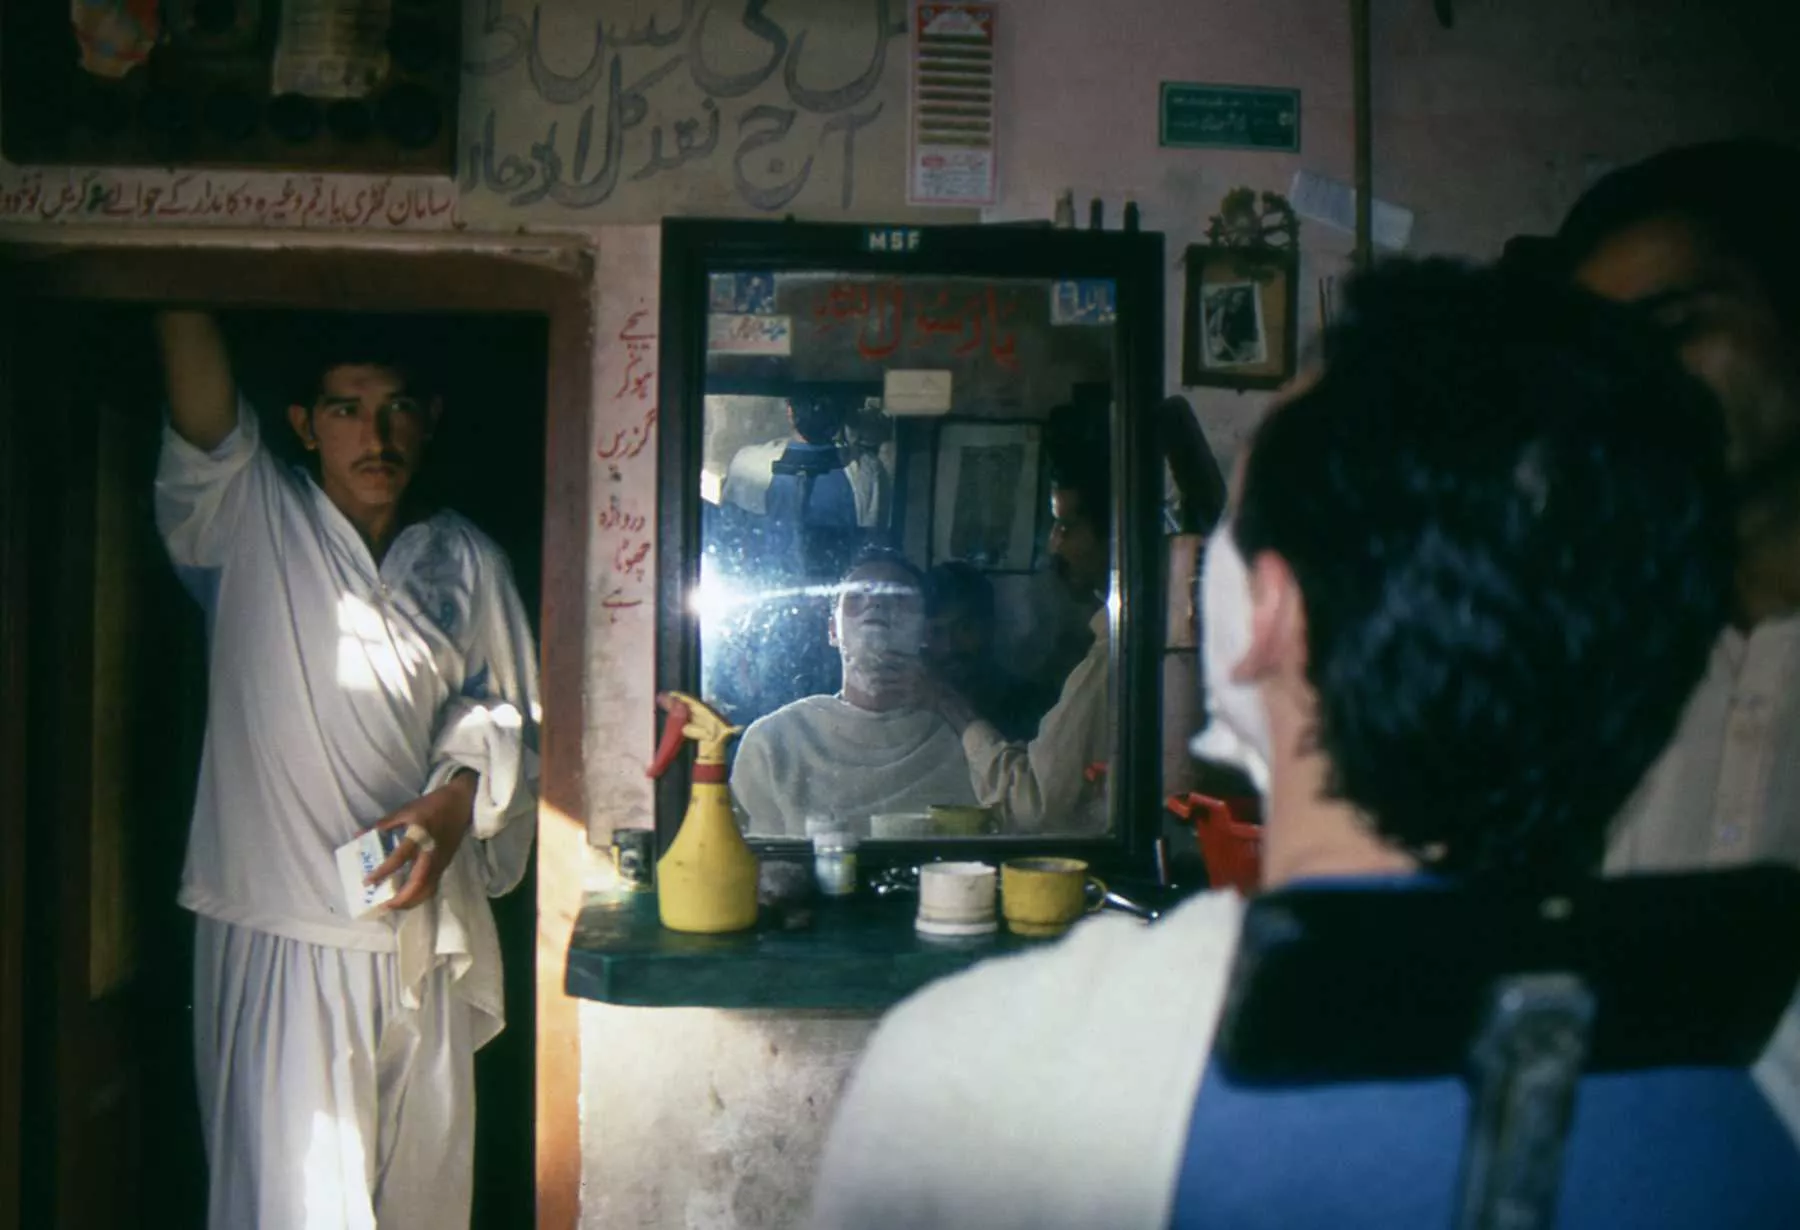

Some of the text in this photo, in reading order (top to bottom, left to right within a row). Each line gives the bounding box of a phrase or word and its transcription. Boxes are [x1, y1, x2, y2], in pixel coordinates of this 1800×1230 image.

[627, 96, 721, 183] نقد
[734, 101, 884, 212] آج
[868, 230, 921, 251] MSF
